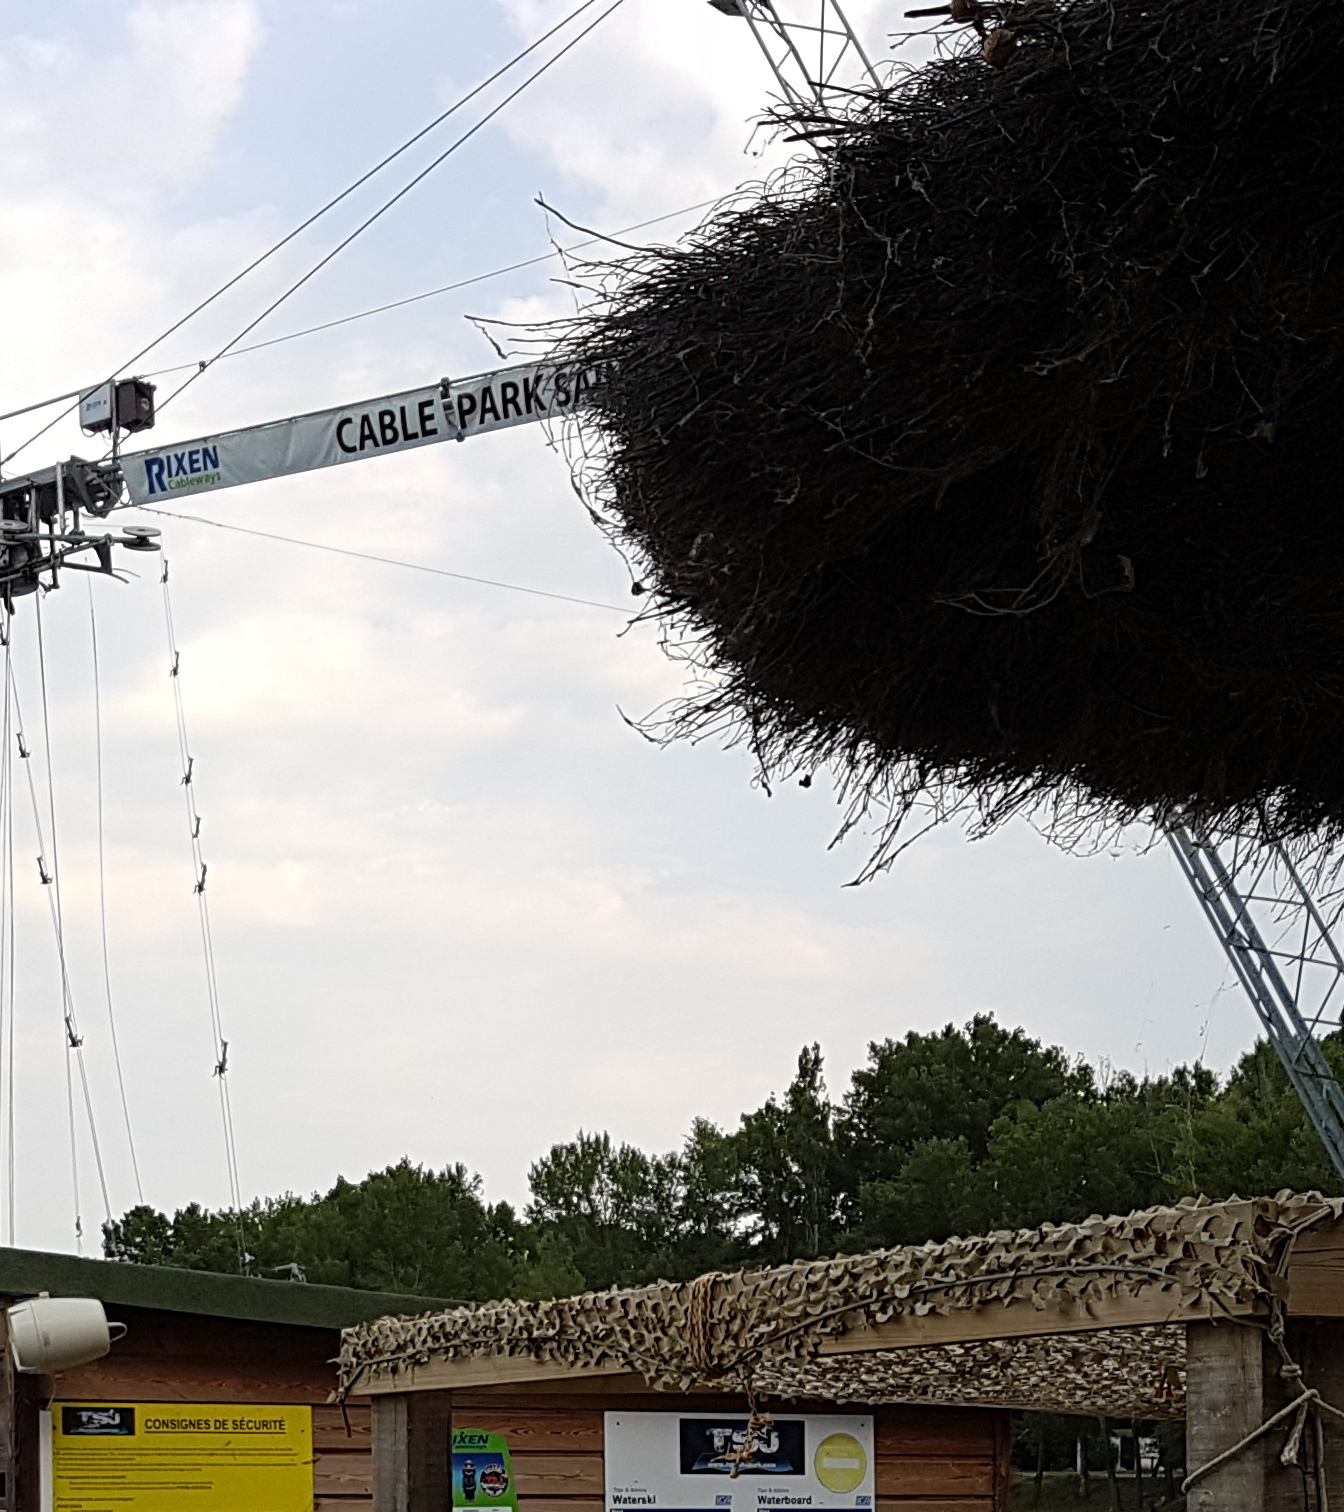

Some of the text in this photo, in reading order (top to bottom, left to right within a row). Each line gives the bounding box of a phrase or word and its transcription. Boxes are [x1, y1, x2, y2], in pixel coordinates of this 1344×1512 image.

[336, 399, 438, 453] CABLE
[457, 373, 547, 430] PARK
[145, 445, 219, 494] RIXEN
[168, 471, 222, 490] Cableways
[144, 1418, 211, 1431] CONSIGNES
[213, 1419, 229, 1430] DE
[231, 1416, 286, 1431] SÉCURITÉ
[453, 1432, 489, 1445] IXEN
[612, 1495, 656, 1505] Waterski
[757, 1495, 812, 1505] Waterboard
